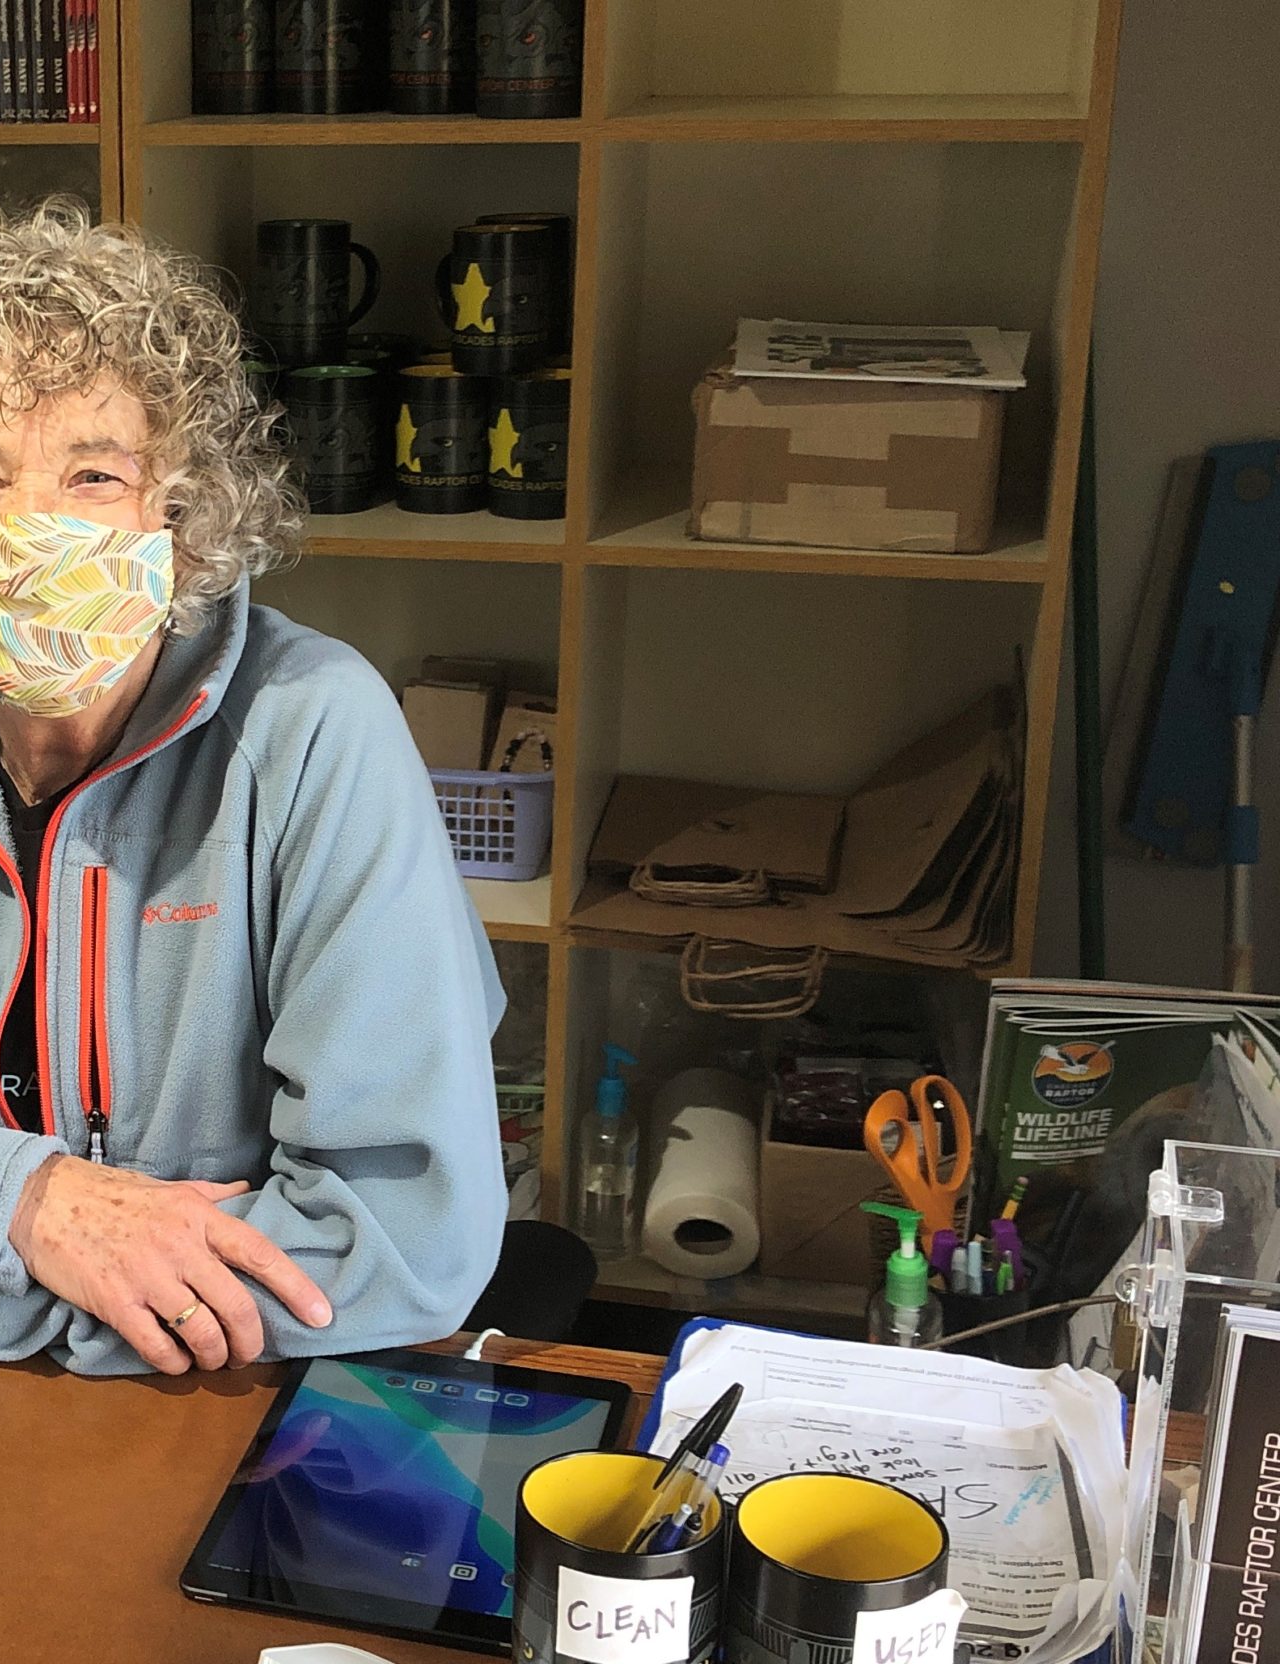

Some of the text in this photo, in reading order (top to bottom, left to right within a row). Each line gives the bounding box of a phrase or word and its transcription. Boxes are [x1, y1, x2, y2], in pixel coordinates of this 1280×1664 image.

[3, 58, 11, 93] DAVIS
[18, 58, 27, 93] DAVIS
[36, 58, 45, 93] DAVIS
[54, 58, 63, 93] DAVIS
[423, 476, 468, 486] RAPTOR
[1045, 1087, 1095, 1098] RAPTOR
[1013, 1122, 1110, 1142] LIFELINE
[1017, 1108, 1114, 1127] WILDLIFE
[862, 1445, 903, 1457] are
[880, 1458, 923, 1471] look
[883, 1469, 937, 1485] some
[1253, 1431, 1280, 1527] CENTER
[1238, 1524, 1277, 1619] RAPTOR
[567, 1599, 676, 1644] CLEAN
[874, 1621, 948, 1664] USED
